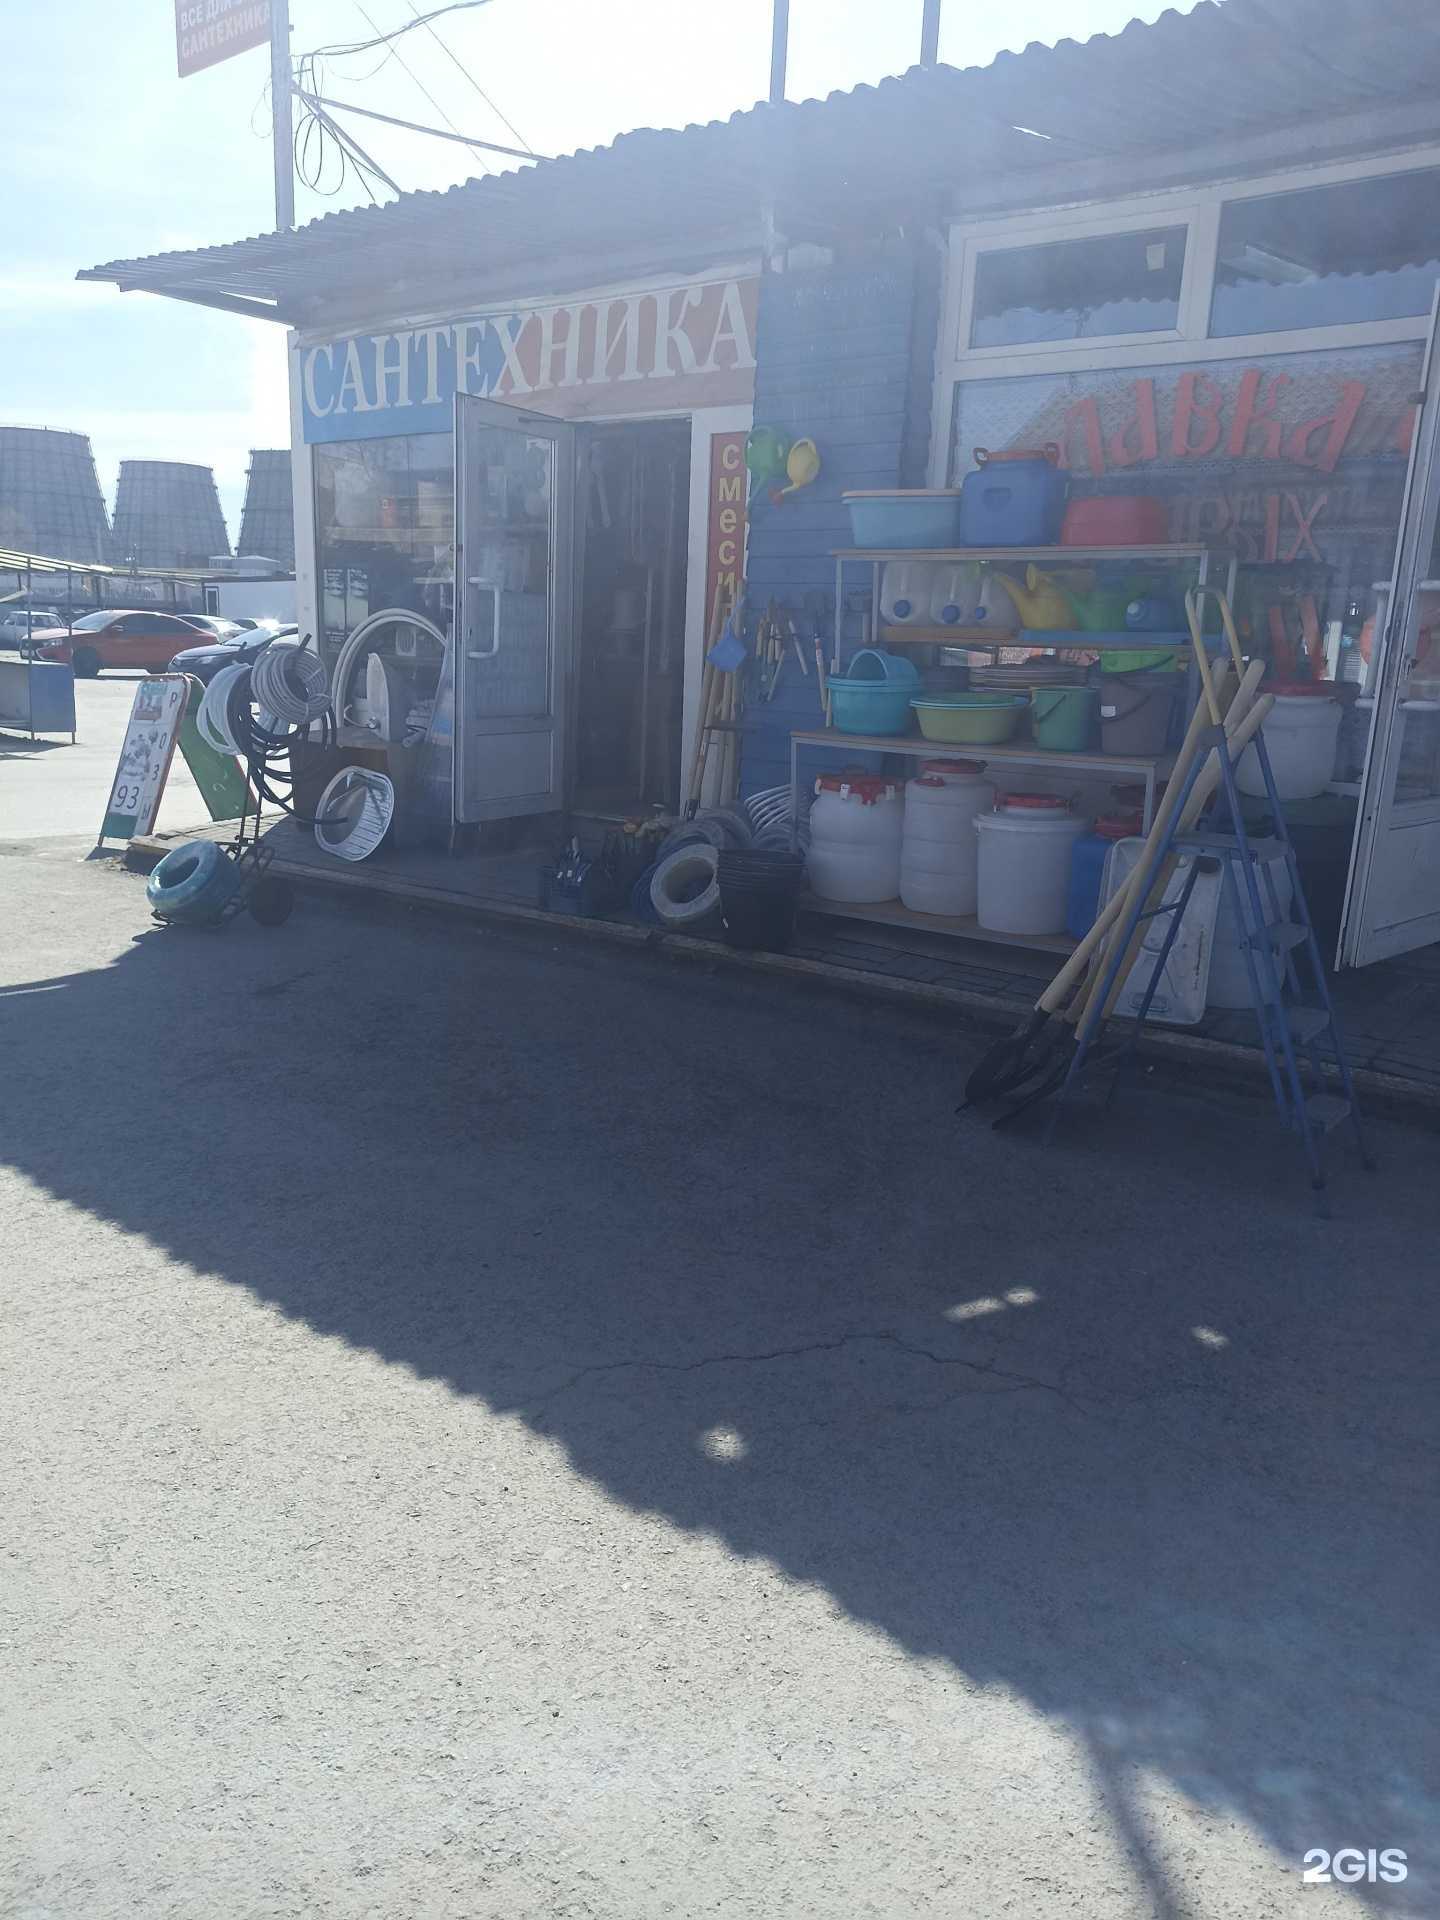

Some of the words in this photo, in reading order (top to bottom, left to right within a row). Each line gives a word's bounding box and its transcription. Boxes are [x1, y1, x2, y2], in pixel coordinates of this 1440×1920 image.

[181, 4, 204, 31] ВСЕ
[304, 280, 757, 418] САНТЕХНИКА
[114, 784, 140, 810] 93
